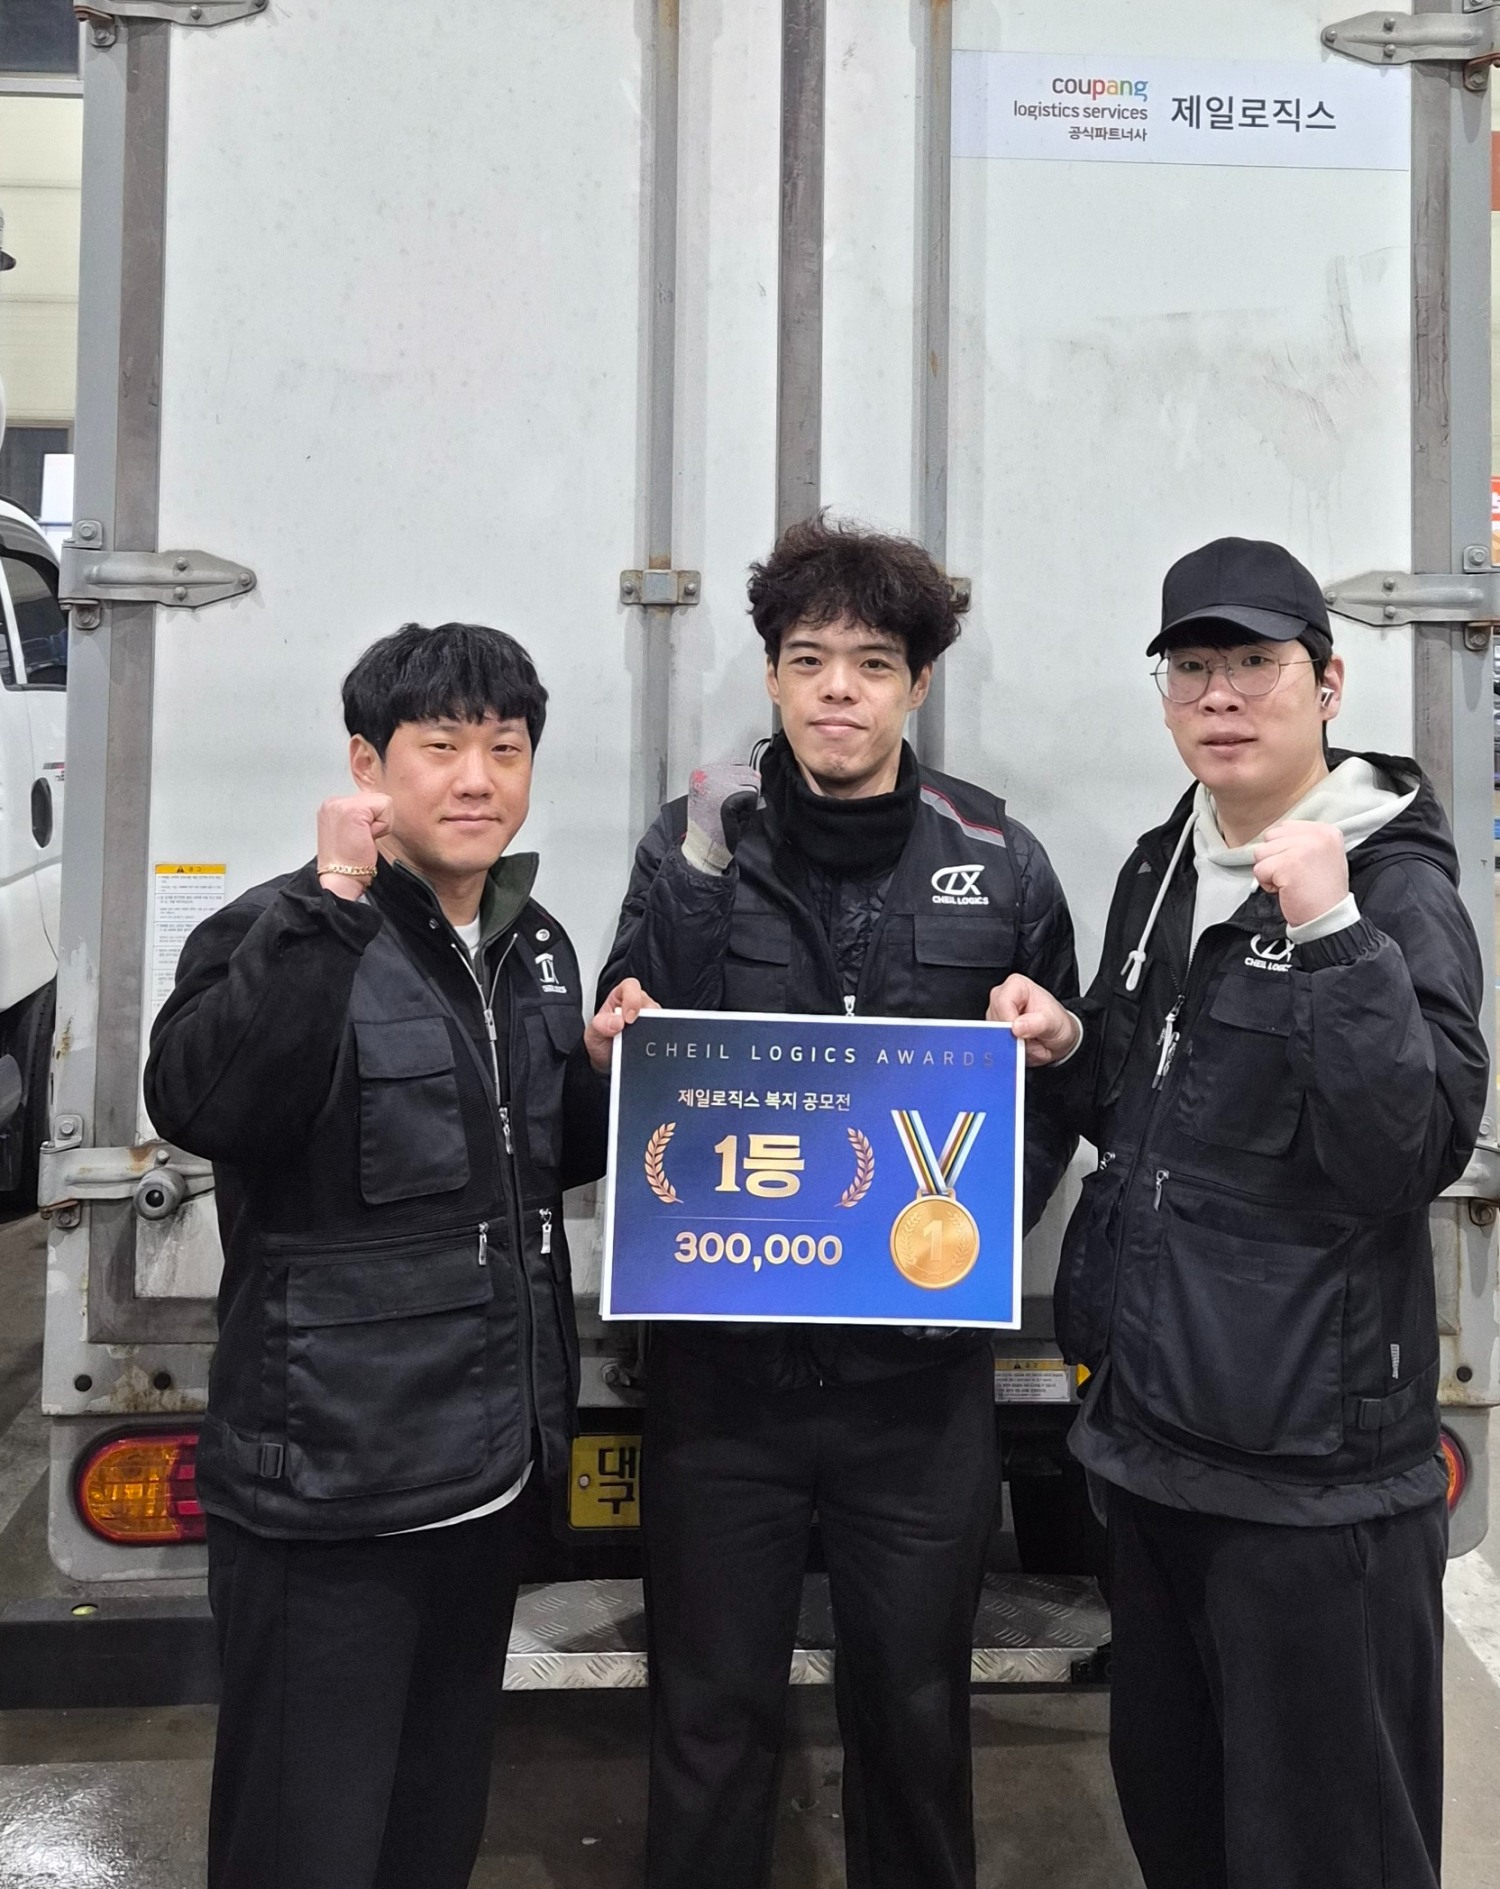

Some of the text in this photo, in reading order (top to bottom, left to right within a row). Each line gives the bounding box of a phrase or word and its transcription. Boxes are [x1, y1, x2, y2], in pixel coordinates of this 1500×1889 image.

[1052, 77, 1148, 101] coupang
[1014, 100, 1148, 120] logistics services
[1171, 95, 1337, 132] 제일로직스
[1068, 126, 1148, 142] 공식파트너사
[957, 896, 989, 906] LOGICS
[646, 1042, 993, 1067] CHEIL LOGICS AWARDS
[678, 1089, 850, 1111] 제일로직스 복지 공모전
[714, 1134, 805, 1198] 1등
[674, 1231, 843, 1273] 300,000
[598, 1447, 636, 1515] 대구
